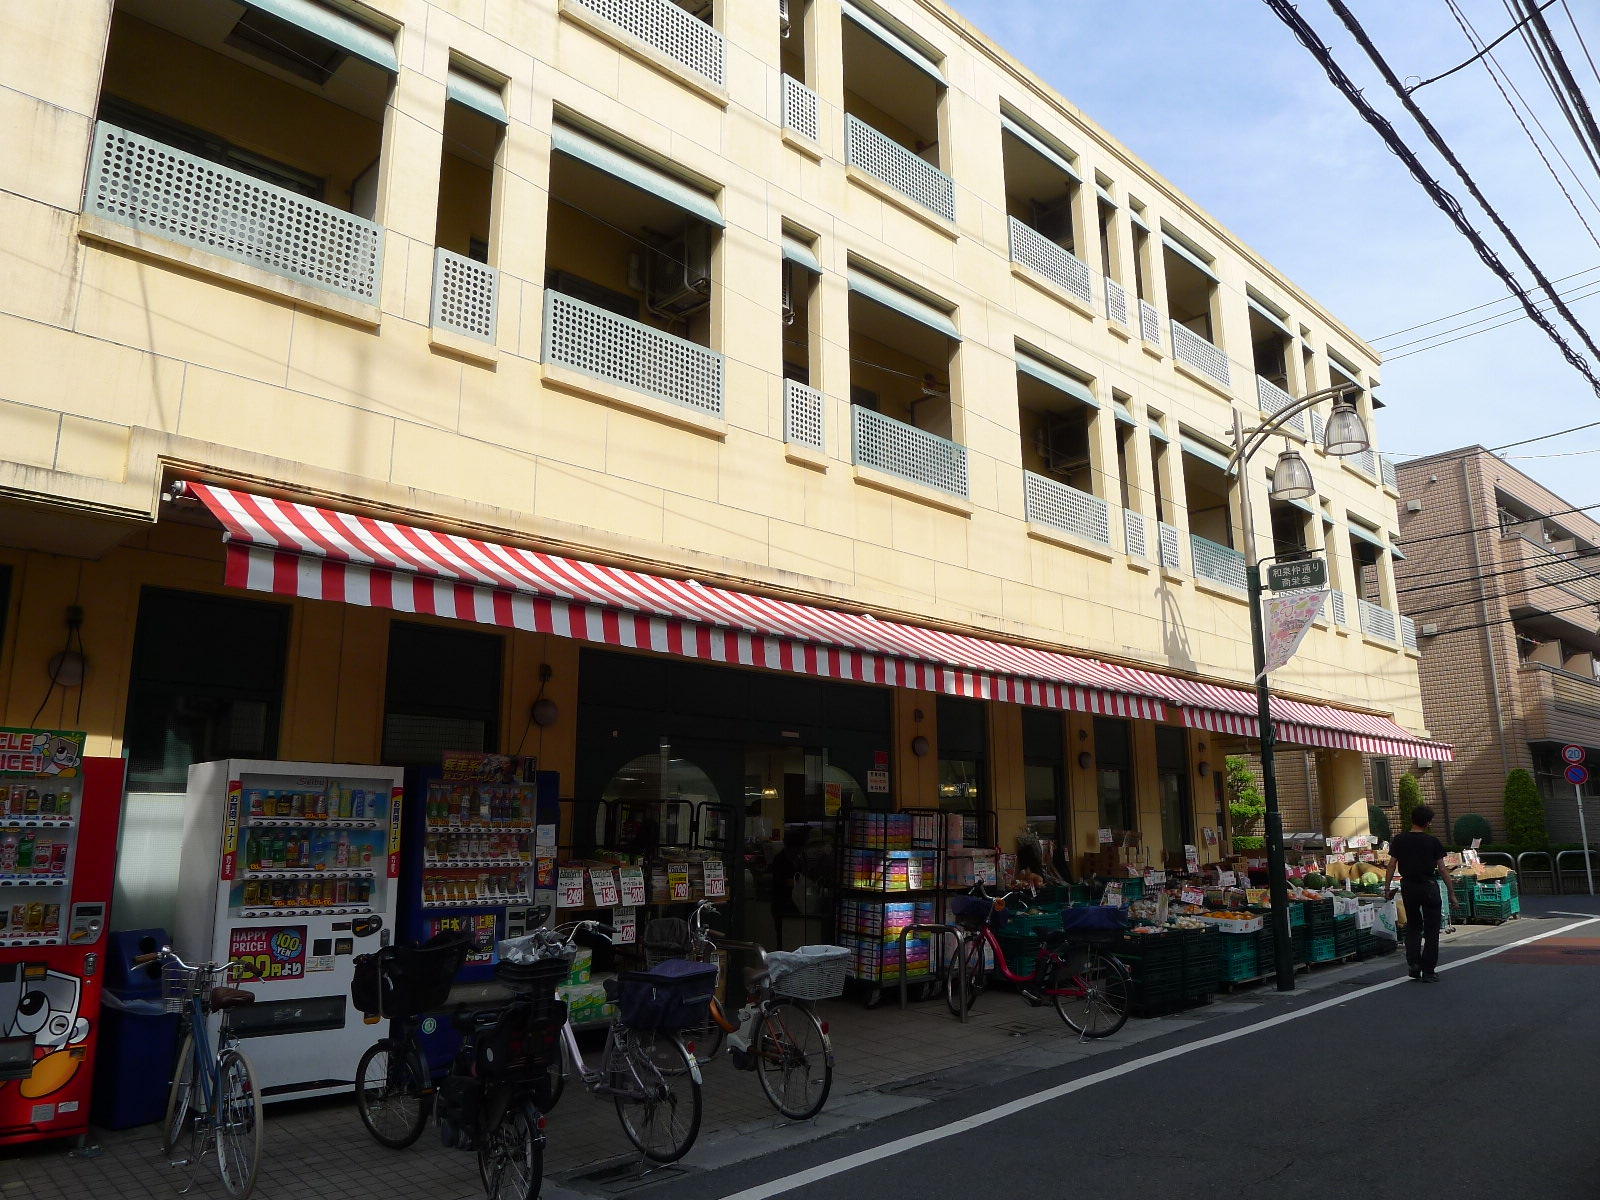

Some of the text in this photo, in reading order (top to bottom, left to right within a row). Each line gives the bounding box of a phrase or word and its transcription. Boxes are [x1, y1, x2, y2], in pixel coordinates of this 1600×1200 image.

[1272, 562, 1319, 578] 和泉仲通り
[1281, 575, 1311, 587] 商栄会
[1567, 749, 1580, 759] 20
[233, 930, 268, 942] HAPPY
[276, 932, 300, 951] 100
[232, 941, 267, 953] PRICE!
[276, 946, 292, 957] YEN
